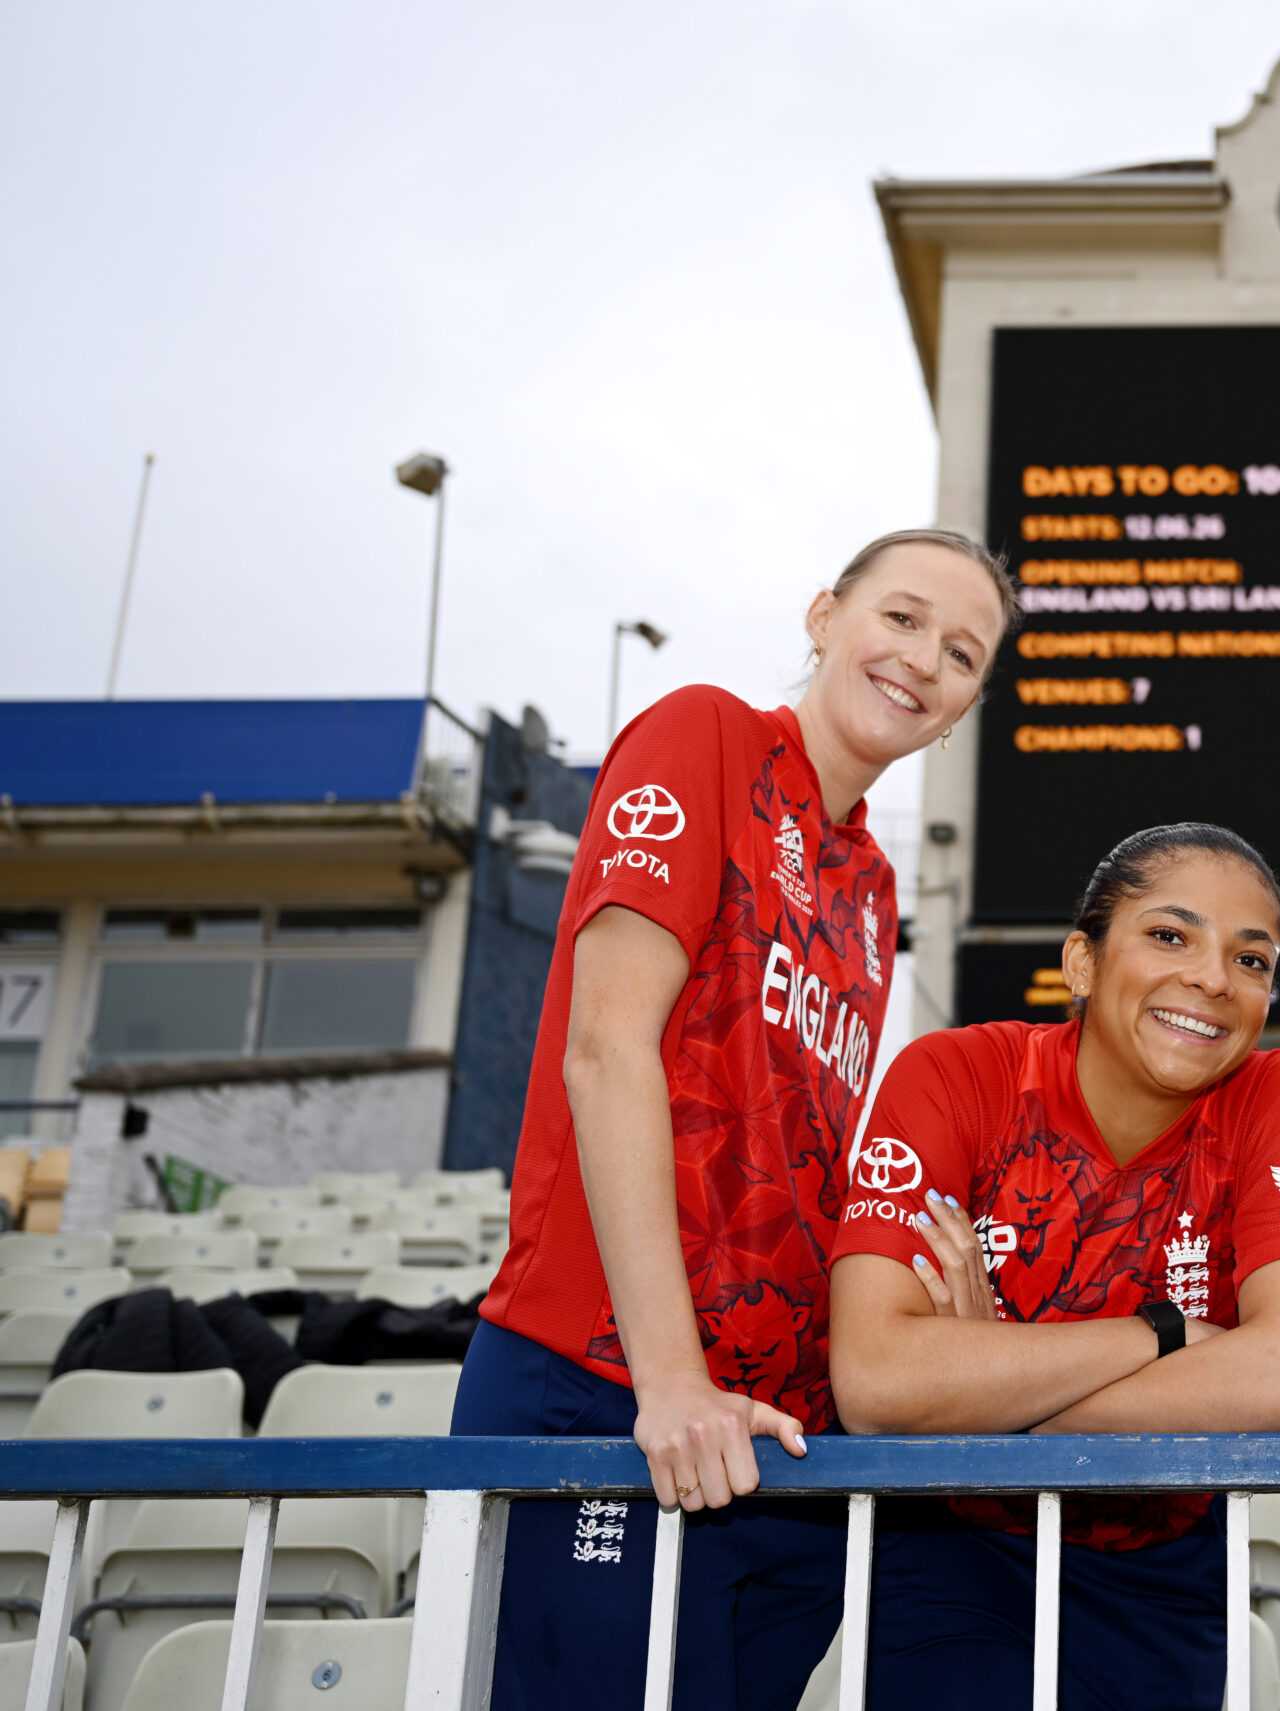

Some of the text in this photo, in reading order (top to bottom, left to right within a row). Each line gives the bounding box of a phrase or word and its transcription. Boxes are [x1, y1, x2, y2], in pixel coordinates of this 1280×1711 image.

[1022, 465, 1114, 496] DAYS
[1116, 464, 1170, 496] TO
[1172, 464, 1239, 496] GO:
[1130, 677, 1151, 704] 7
[1185, 724, 1202, 751] 1
[600, 849, 669, 884] TYOTA
[784, 856, 798, 873] ICC
[794, 887, 812, 904] CUP
[762, 941, 869, 1098] ENGLAND
